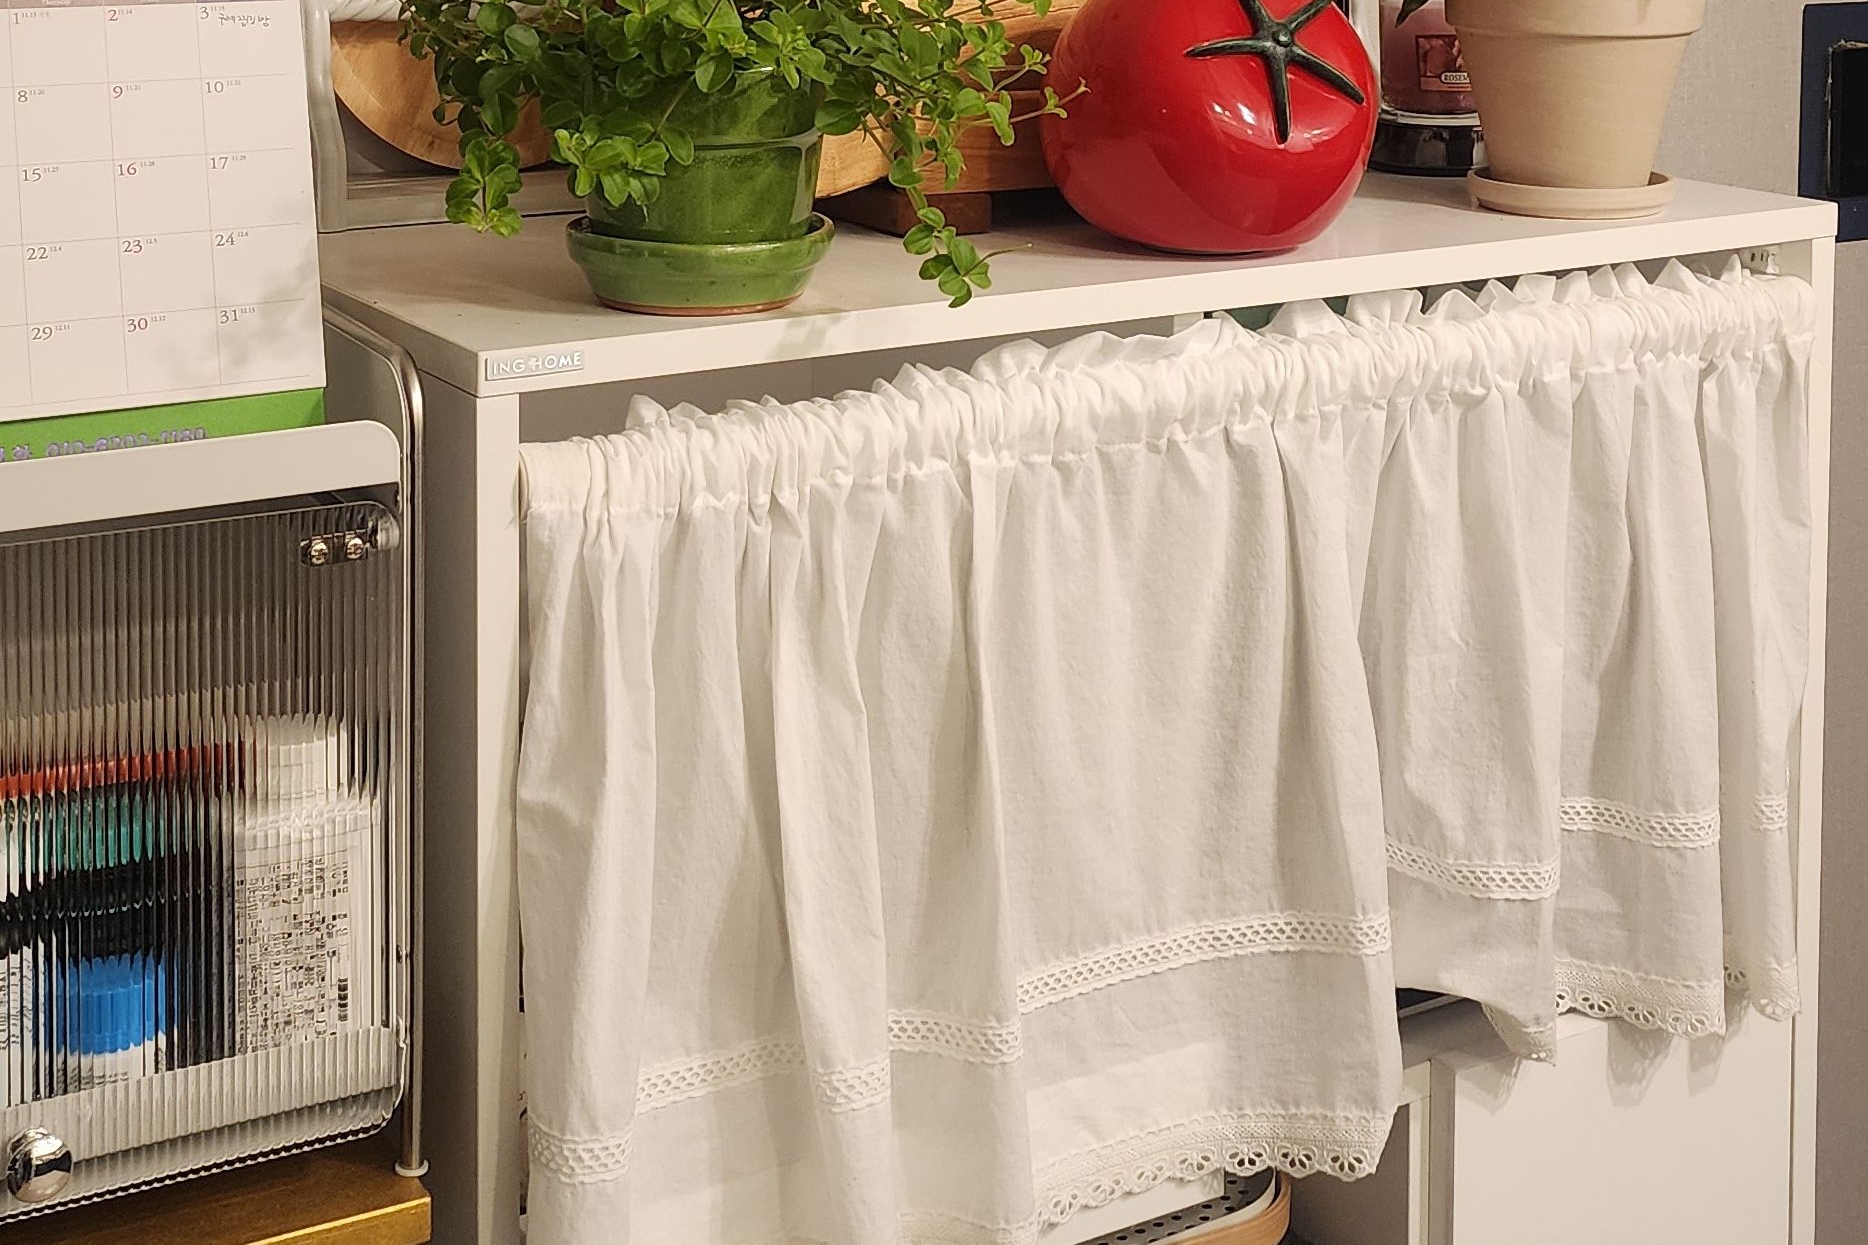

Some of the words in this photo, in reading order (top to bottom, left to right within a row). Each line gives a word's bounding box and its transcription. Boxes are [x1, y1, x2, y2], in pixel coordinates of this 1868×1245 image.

[13, 12, 22, 25] 1
[108, 9, 118, 21] 2
[200, 6, 209, 19] 3
[112, 85, 123, 99] 9
[205, 80, 224, 94] 10
[17, 89, 28, 102] 8
[117, 161, 137, 176] 16
[209, 156, 229, 169] 17
[22, 167, 42, 182] 15
[215, 231, 236, 247] 24
[26, 246, 48, 260] 22
[121, 239, 143, 254] 23
[219, 309, 239, 324] 31
[126, 317, 148, 333] 30
[31, 326, 53, 341] 29
